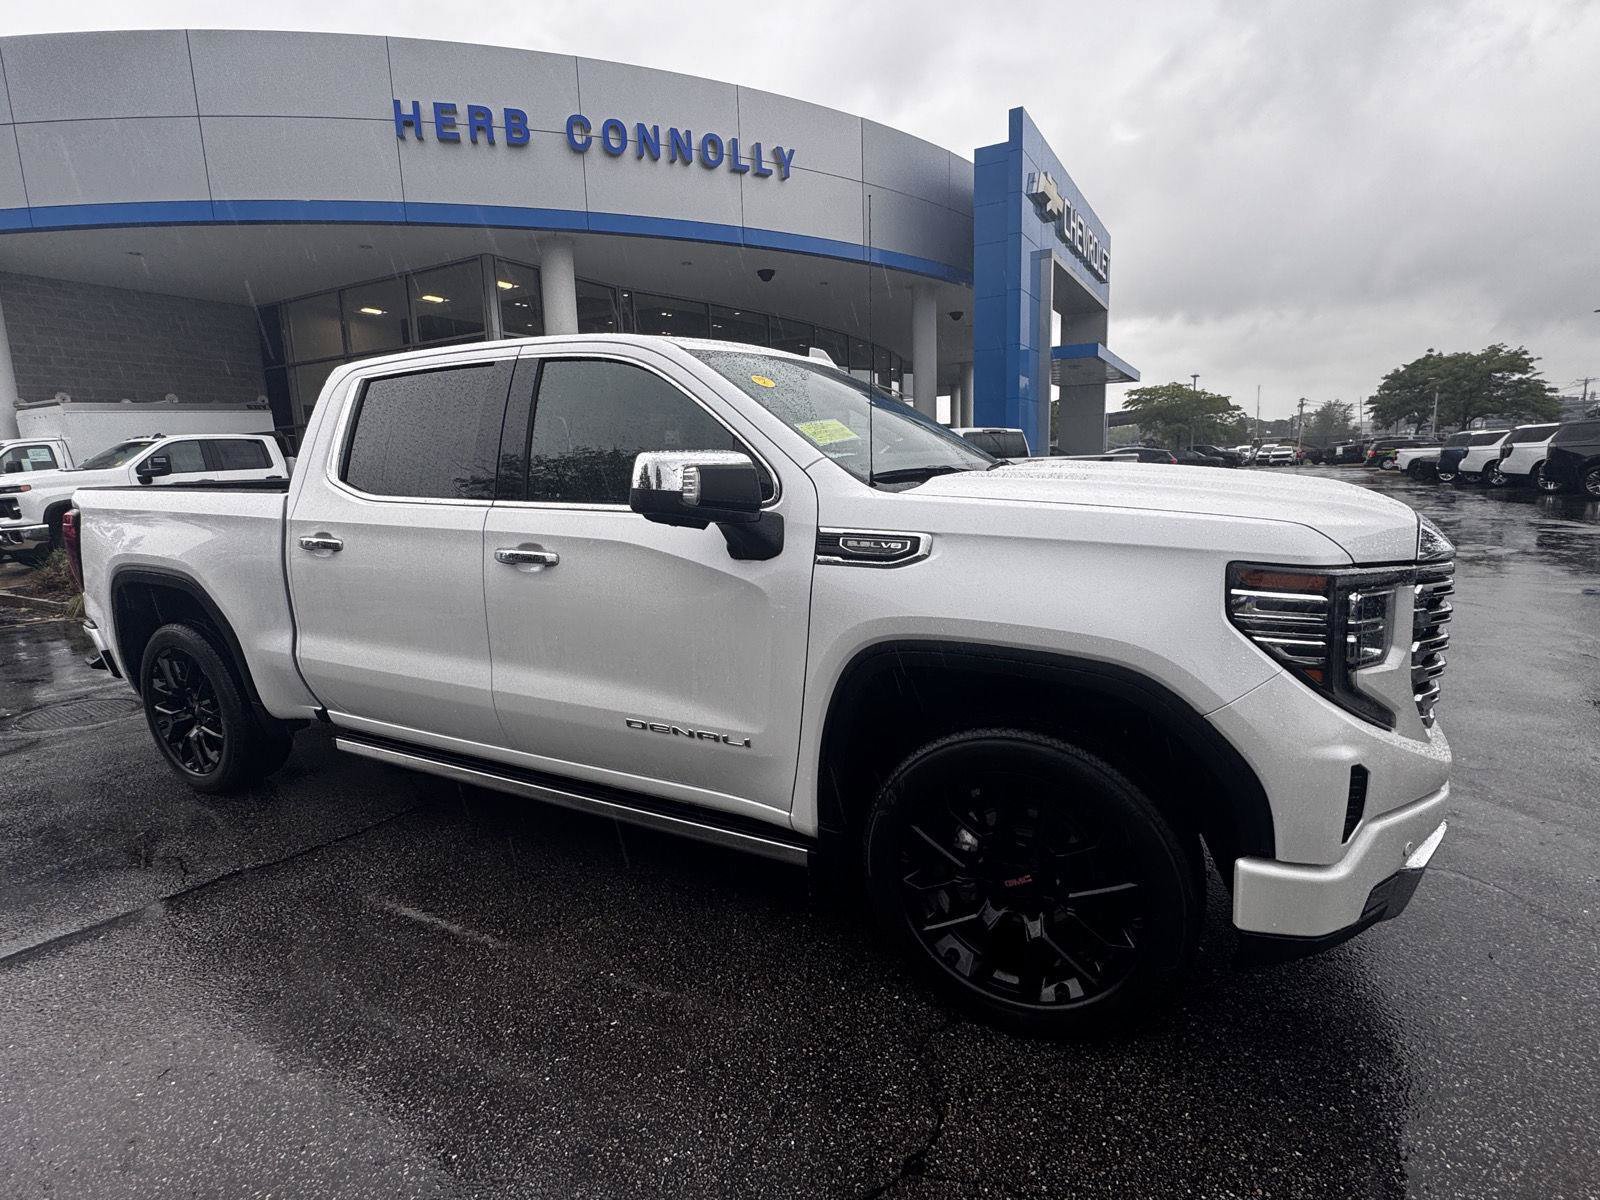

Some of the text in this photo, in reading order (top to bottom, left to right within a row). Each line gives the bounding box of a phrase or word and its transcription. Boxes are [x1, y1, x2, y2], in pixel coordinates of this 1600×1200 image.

[393, 99, 796, 180] HERB CONNOLLY
[1059, 197, 1111, 283] CHEVROLET
[625, 717, 751, 748] DENALI
